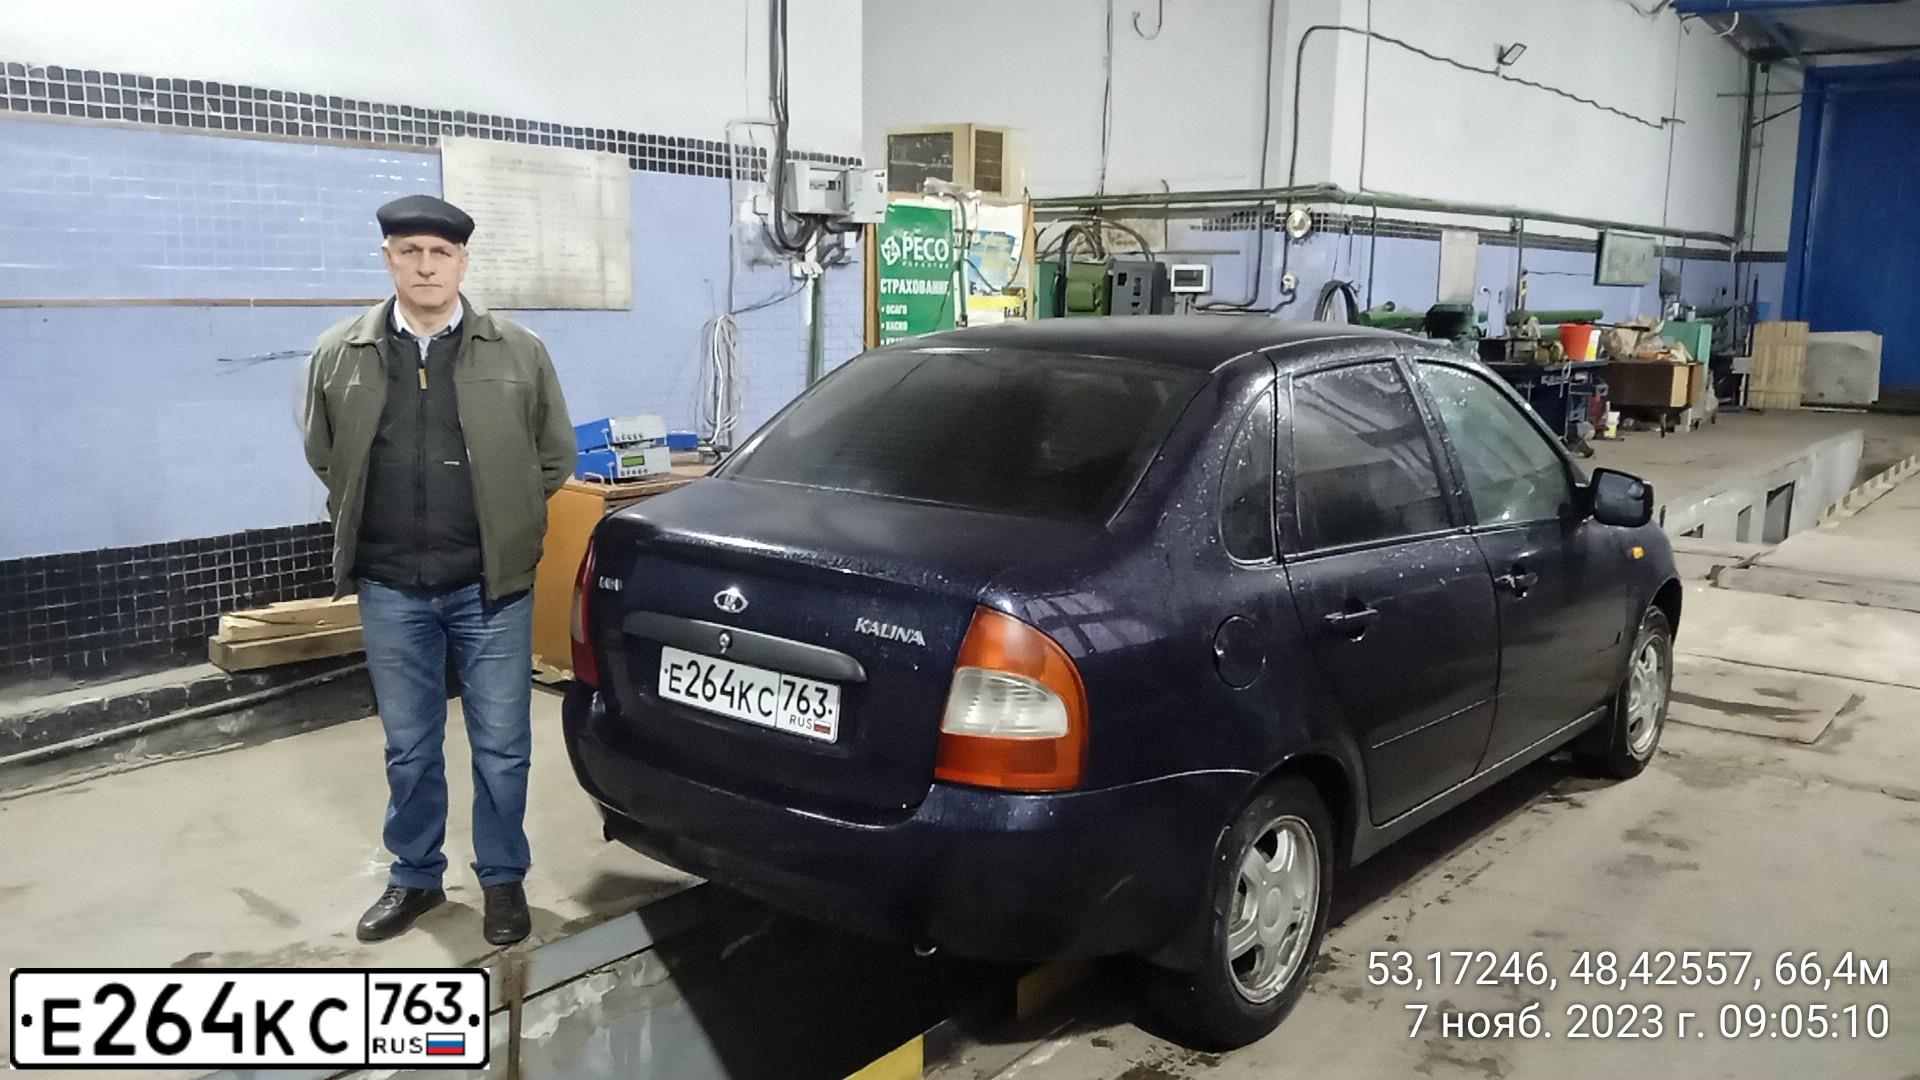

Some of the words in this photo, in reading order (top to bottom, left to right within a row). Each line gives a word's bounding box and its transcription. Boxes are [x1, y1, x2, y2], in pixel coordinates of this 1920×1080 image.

[854, 617, 926, 647] KALINA
[782, 679, 829, 719] 763
[789, 714, 813, 730] RUS
